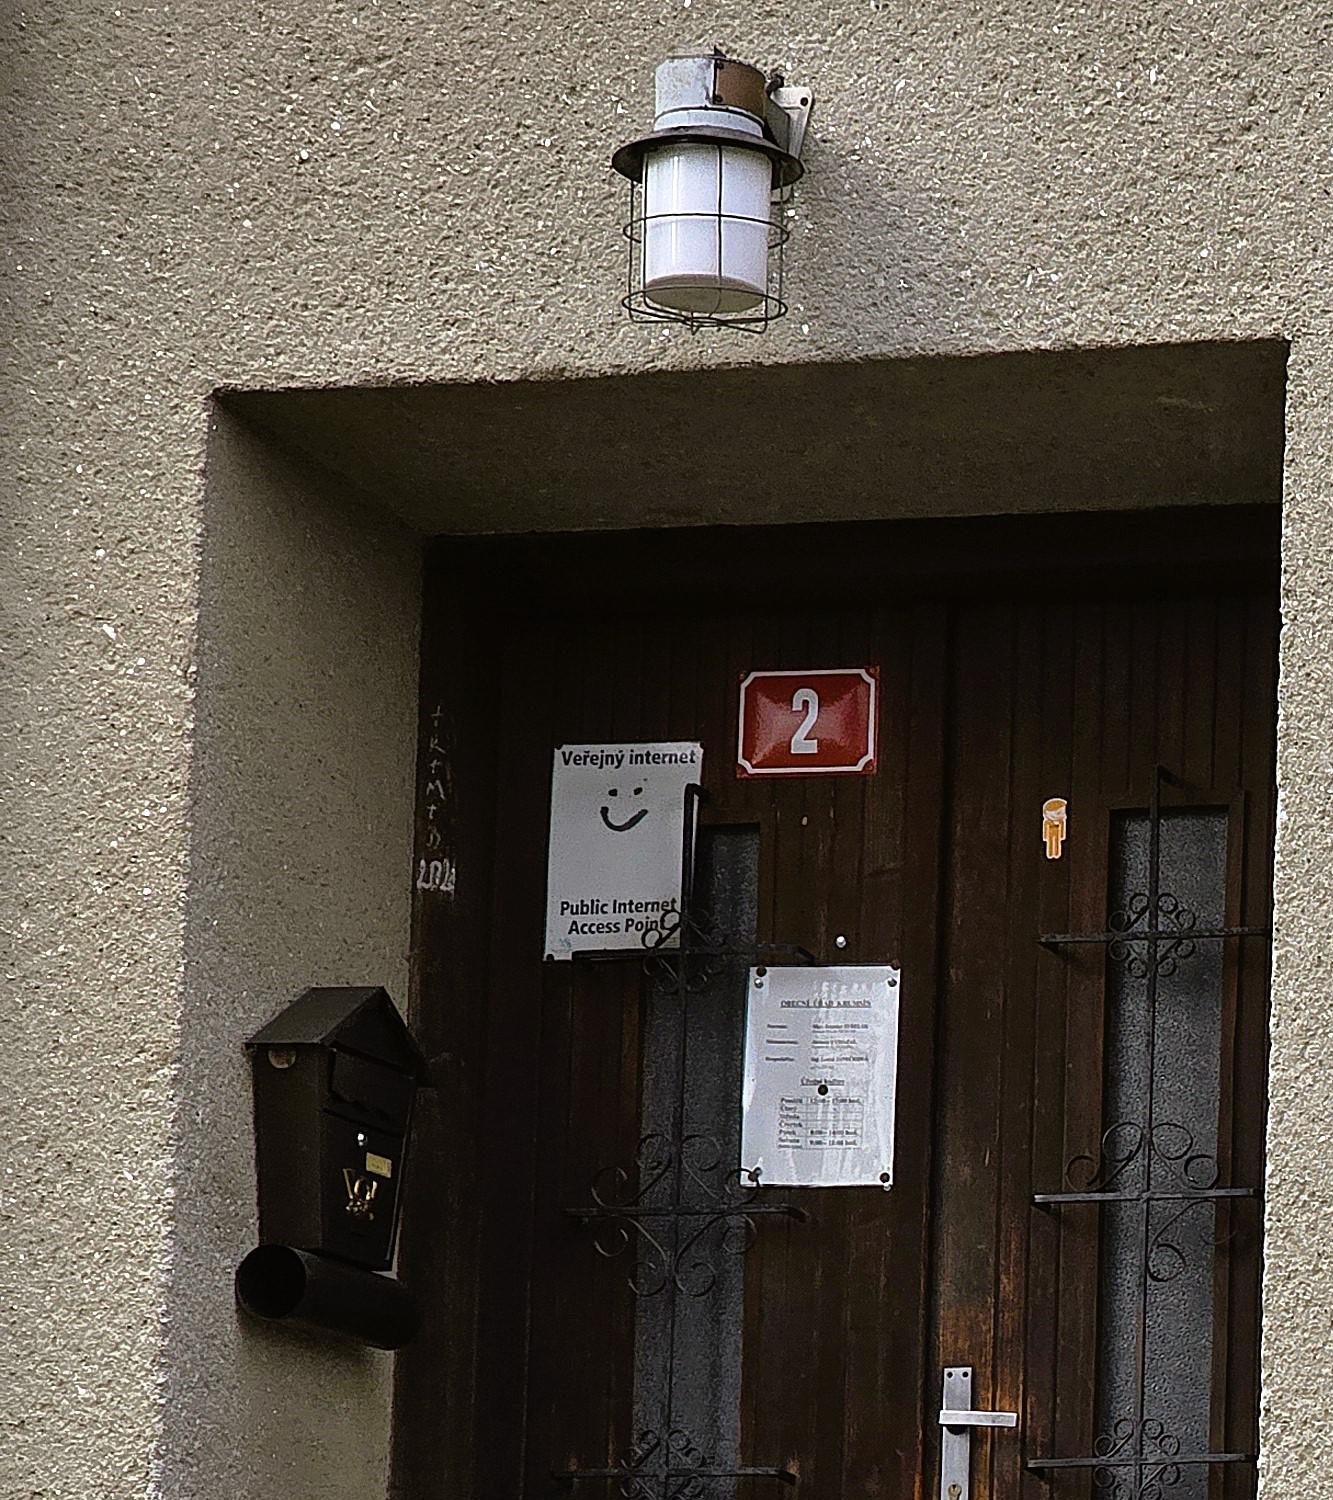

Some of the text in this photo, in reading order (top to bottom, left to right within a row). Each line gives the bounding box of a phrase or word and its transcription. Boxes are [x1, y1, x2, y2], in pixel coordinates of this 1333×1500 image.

[790, 688, 819, 754] 2
[561, 749, 697, 769] Veřejný internet
[560, 898, 677, 916] Public Internet
[568, 916, 665, 935] Access Poin
